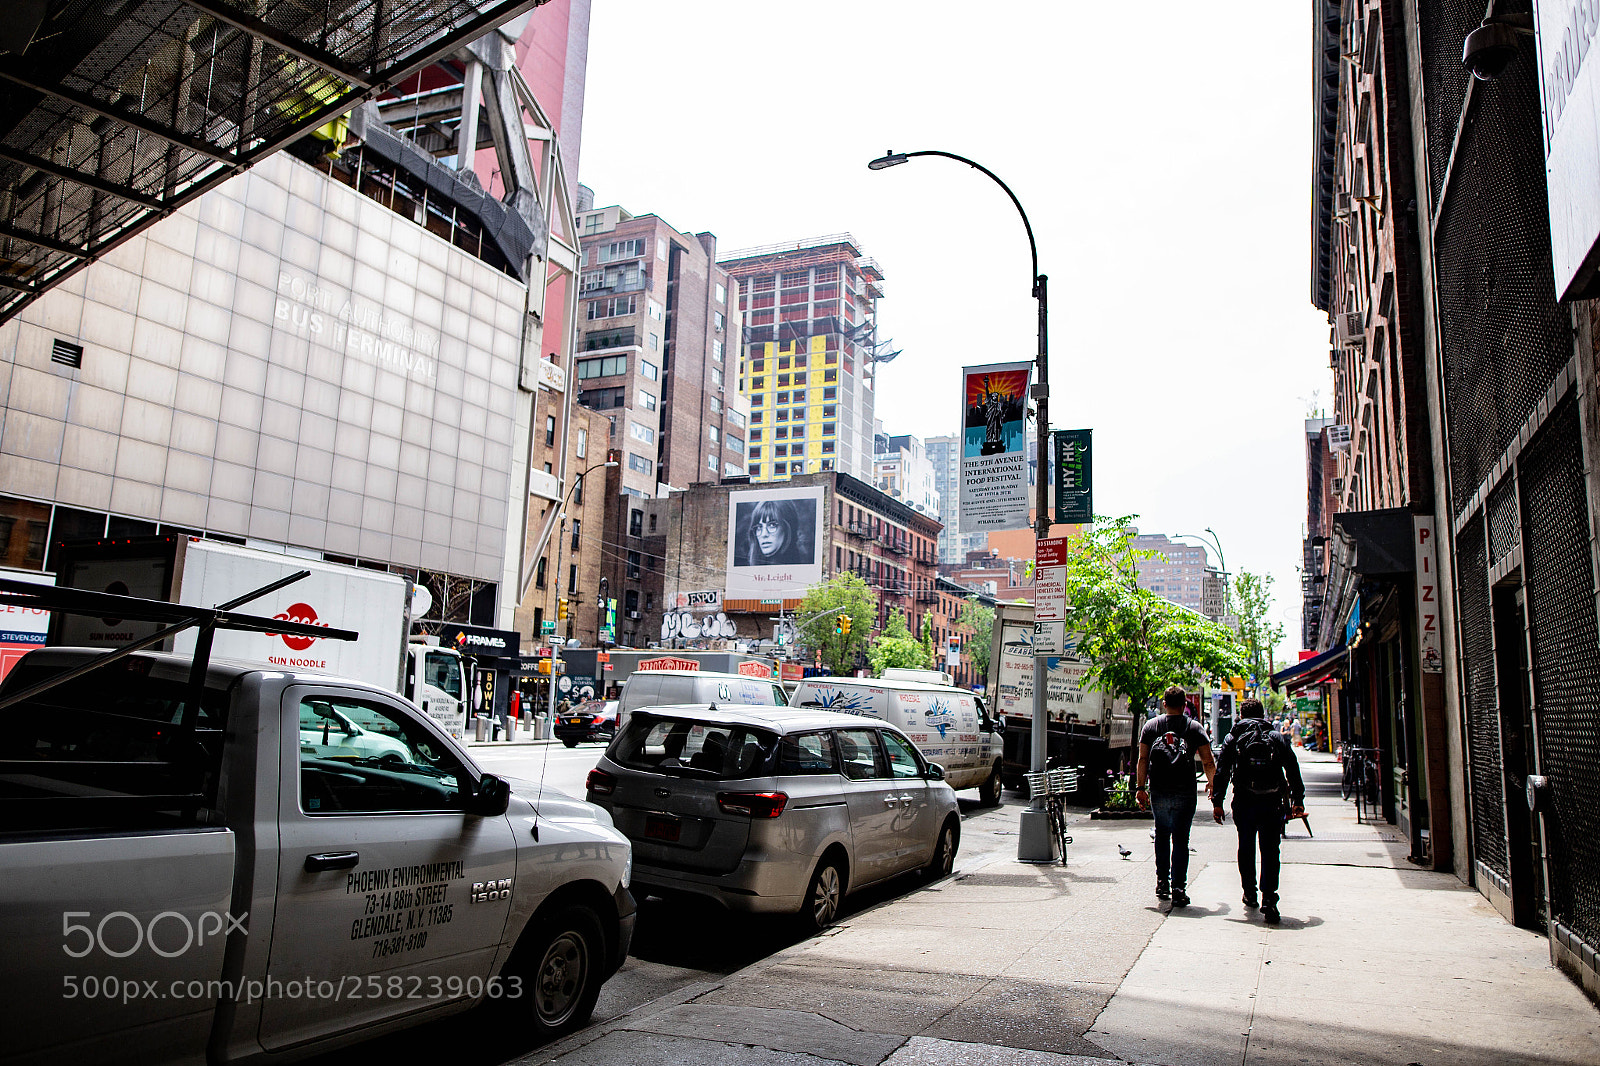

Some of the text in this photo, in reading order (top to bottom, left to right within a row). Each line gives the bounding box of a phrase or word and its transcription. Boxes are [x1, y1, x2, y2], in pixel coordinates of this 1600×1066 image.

[278, 271, 440, 357] PORT AUTHORITY
[274, 299, 437, 380] BUS TERMINAL
[980, 459, 993, 467] 9TH
[994, 455, 1024, 464] AVENUE
[965, 465, 1023, 477] INTERNATIONAL
[966, 474, 1022, 485] FOOD FESTIVAL
[1043, 539, 1063, 547] STANDING
[1037, 570, 1042, 580] 3
[690, 592, 716, 605] ESPO
[1035, 623, 1040, 633] 2
[89, 632, 134, 641] SUN NOODLE
[466, 634, 506, 648] FRAMES
[268, 656, 327, 669] SUN NOODLE
[521, 663, 539, 671] COFFE
[484, 672, 493, 711] BOWL
[1076, 694, 1084, 703] NY
[346, 860, 465, 895] PHOENIX ENVIRONMENTAL
[471, 877, 512, 894] RAM
[364, 883, 449, 915] 73-14 88th STREET
[470, 889, 511, 905] 1500
[351, 904, 454, 940] GLENDALE, N.Y. 11385
[372, 931, 428, 959] 718-381-8100
